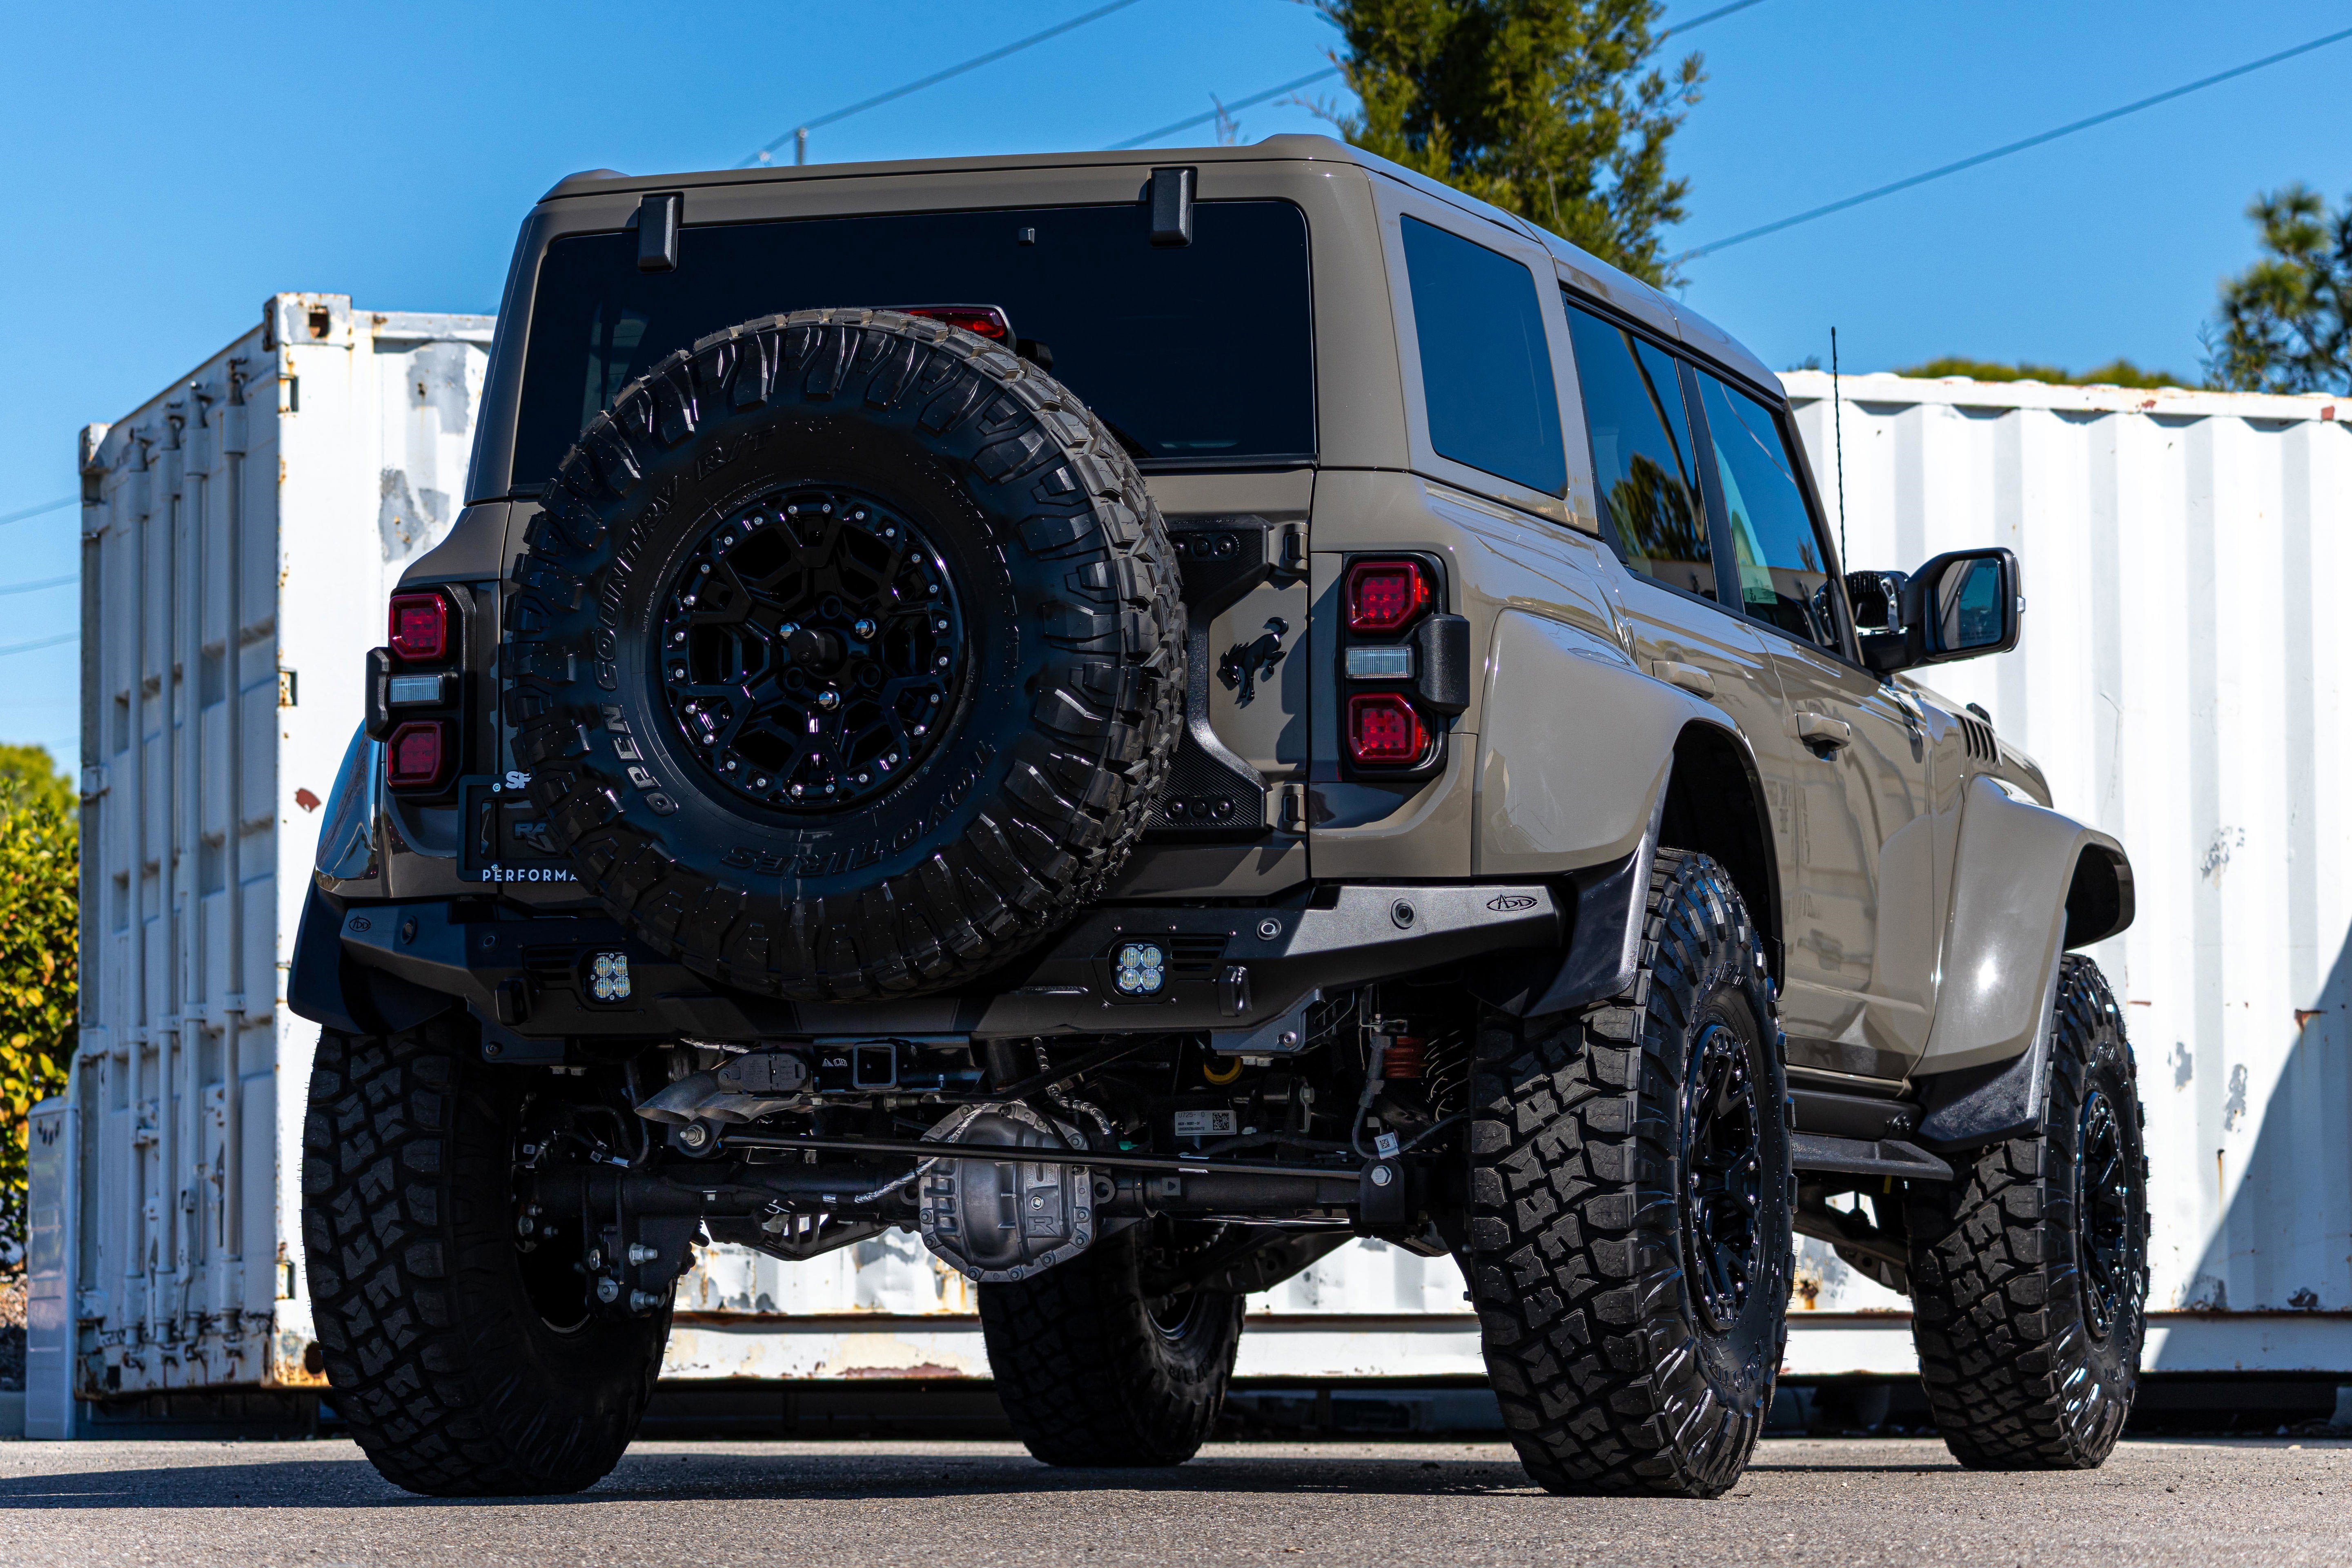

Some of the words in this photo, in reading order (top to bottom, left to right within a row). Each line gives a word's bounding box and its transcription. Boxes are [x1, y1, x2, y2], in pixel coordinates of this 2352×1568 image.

[695, 425, 775, 481] R/T
[594, 475, 678, 691] COUNTRY
[600, 703, 679, 816] OPEN
[722, 839, 884, 876] TIRES
